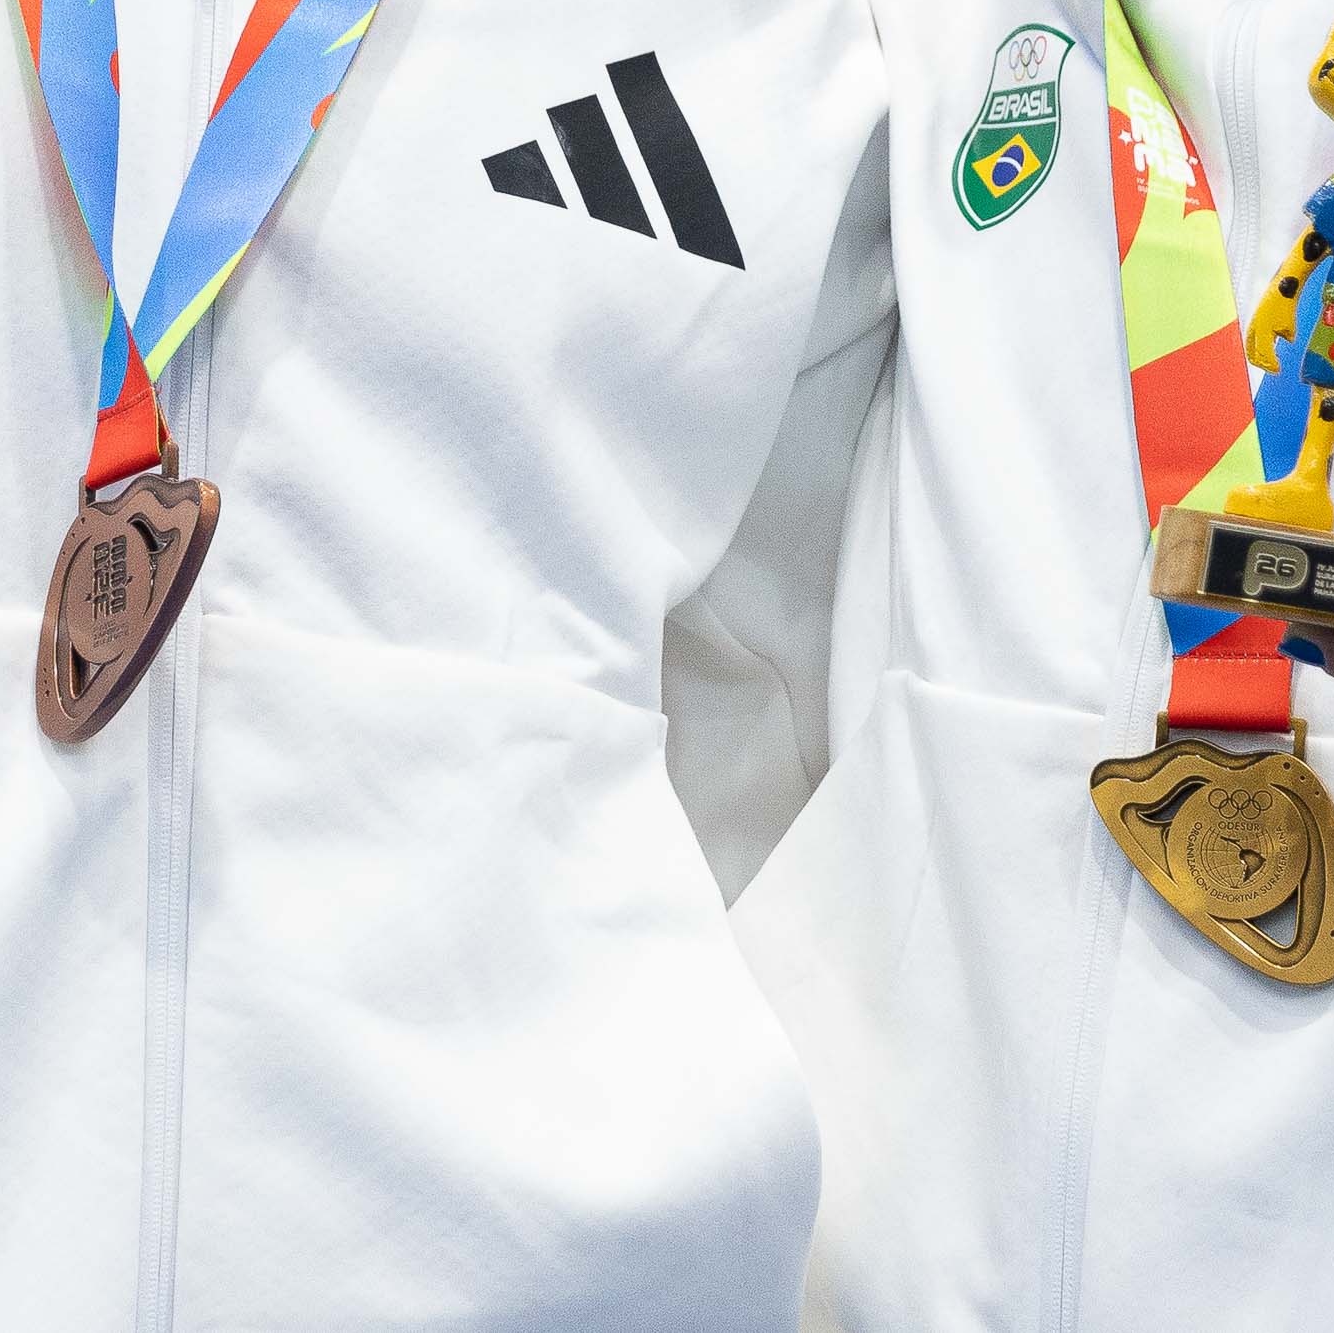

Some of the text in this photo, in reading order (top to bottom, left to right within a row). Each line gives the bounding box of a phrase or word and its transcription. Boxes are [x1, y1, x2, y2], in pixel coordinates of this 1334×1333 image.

[988, 89, 1053, 122] BRASIL
[1255, 552, 1297, 577] 26
[1218, 821, 1260, 831] ODESUR
[1187, 822, 1289, 902] ORGANIZACION DEPORTIVA SURAMERICANA
